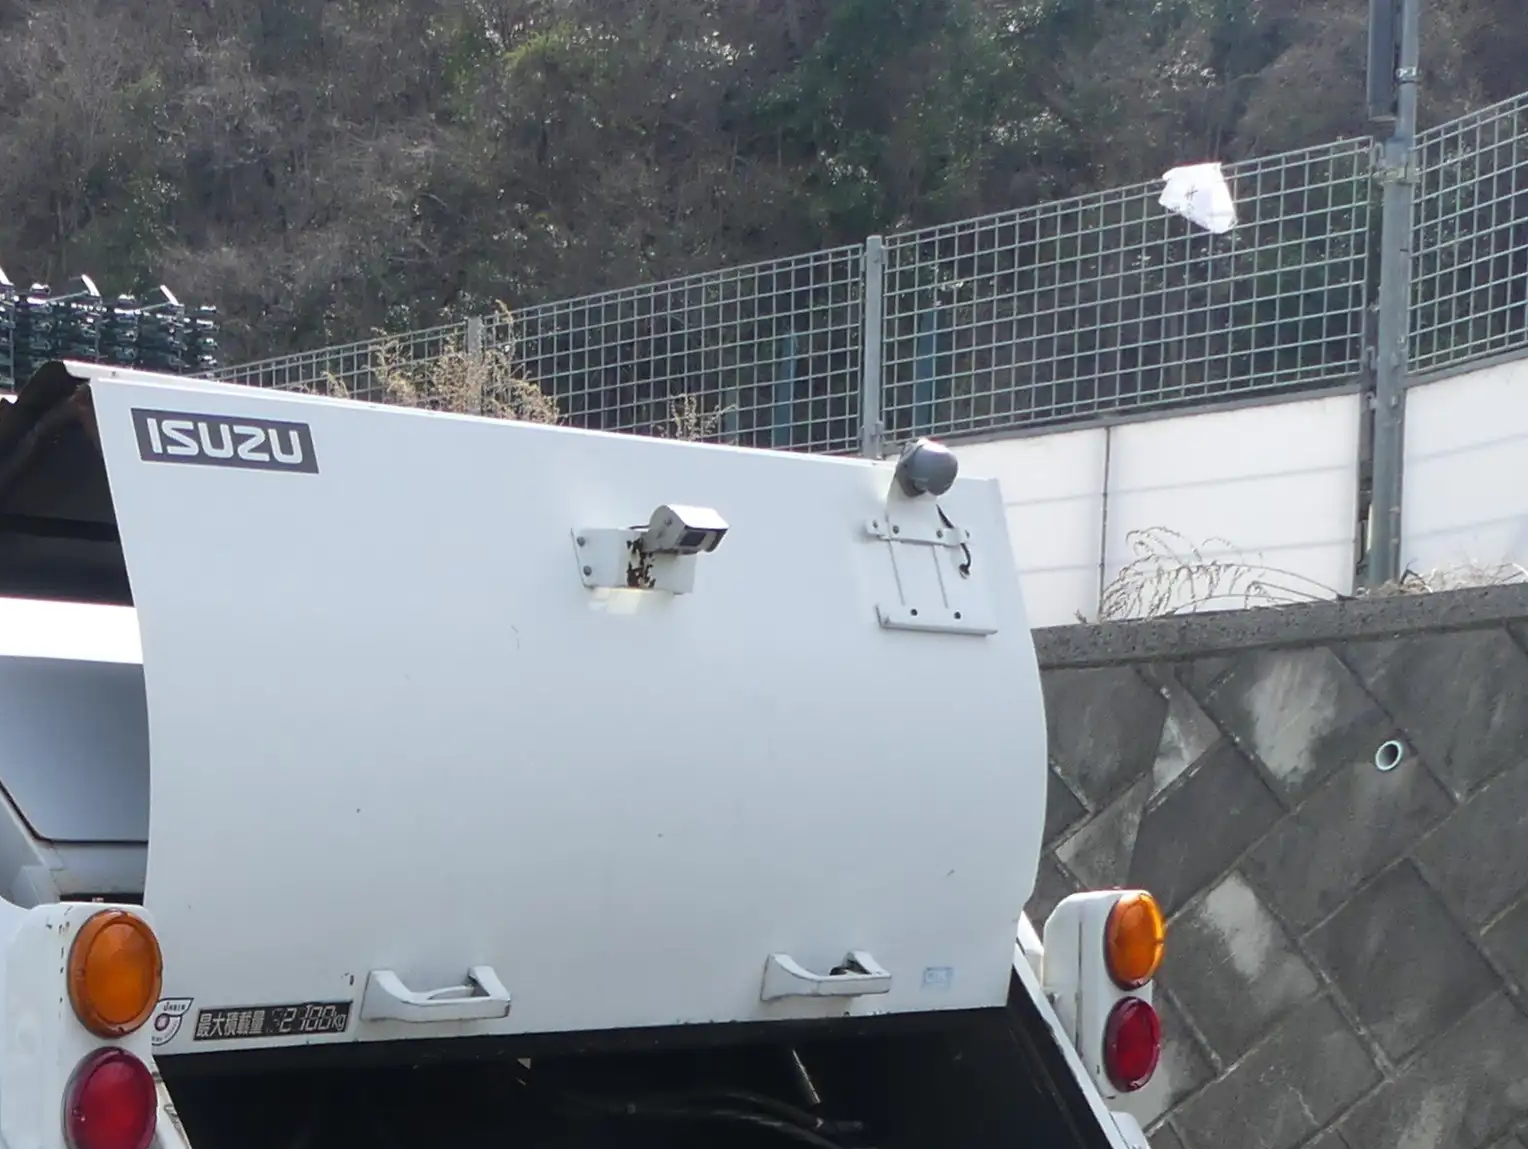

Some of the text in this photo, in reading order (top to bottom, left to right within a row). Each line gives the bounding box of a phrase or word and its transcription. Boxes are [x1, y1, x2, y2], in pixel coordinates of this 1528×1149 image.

[146, 417, 304, 464] ISUZU
[196, 1009, 265, 1037] 最大積載量
